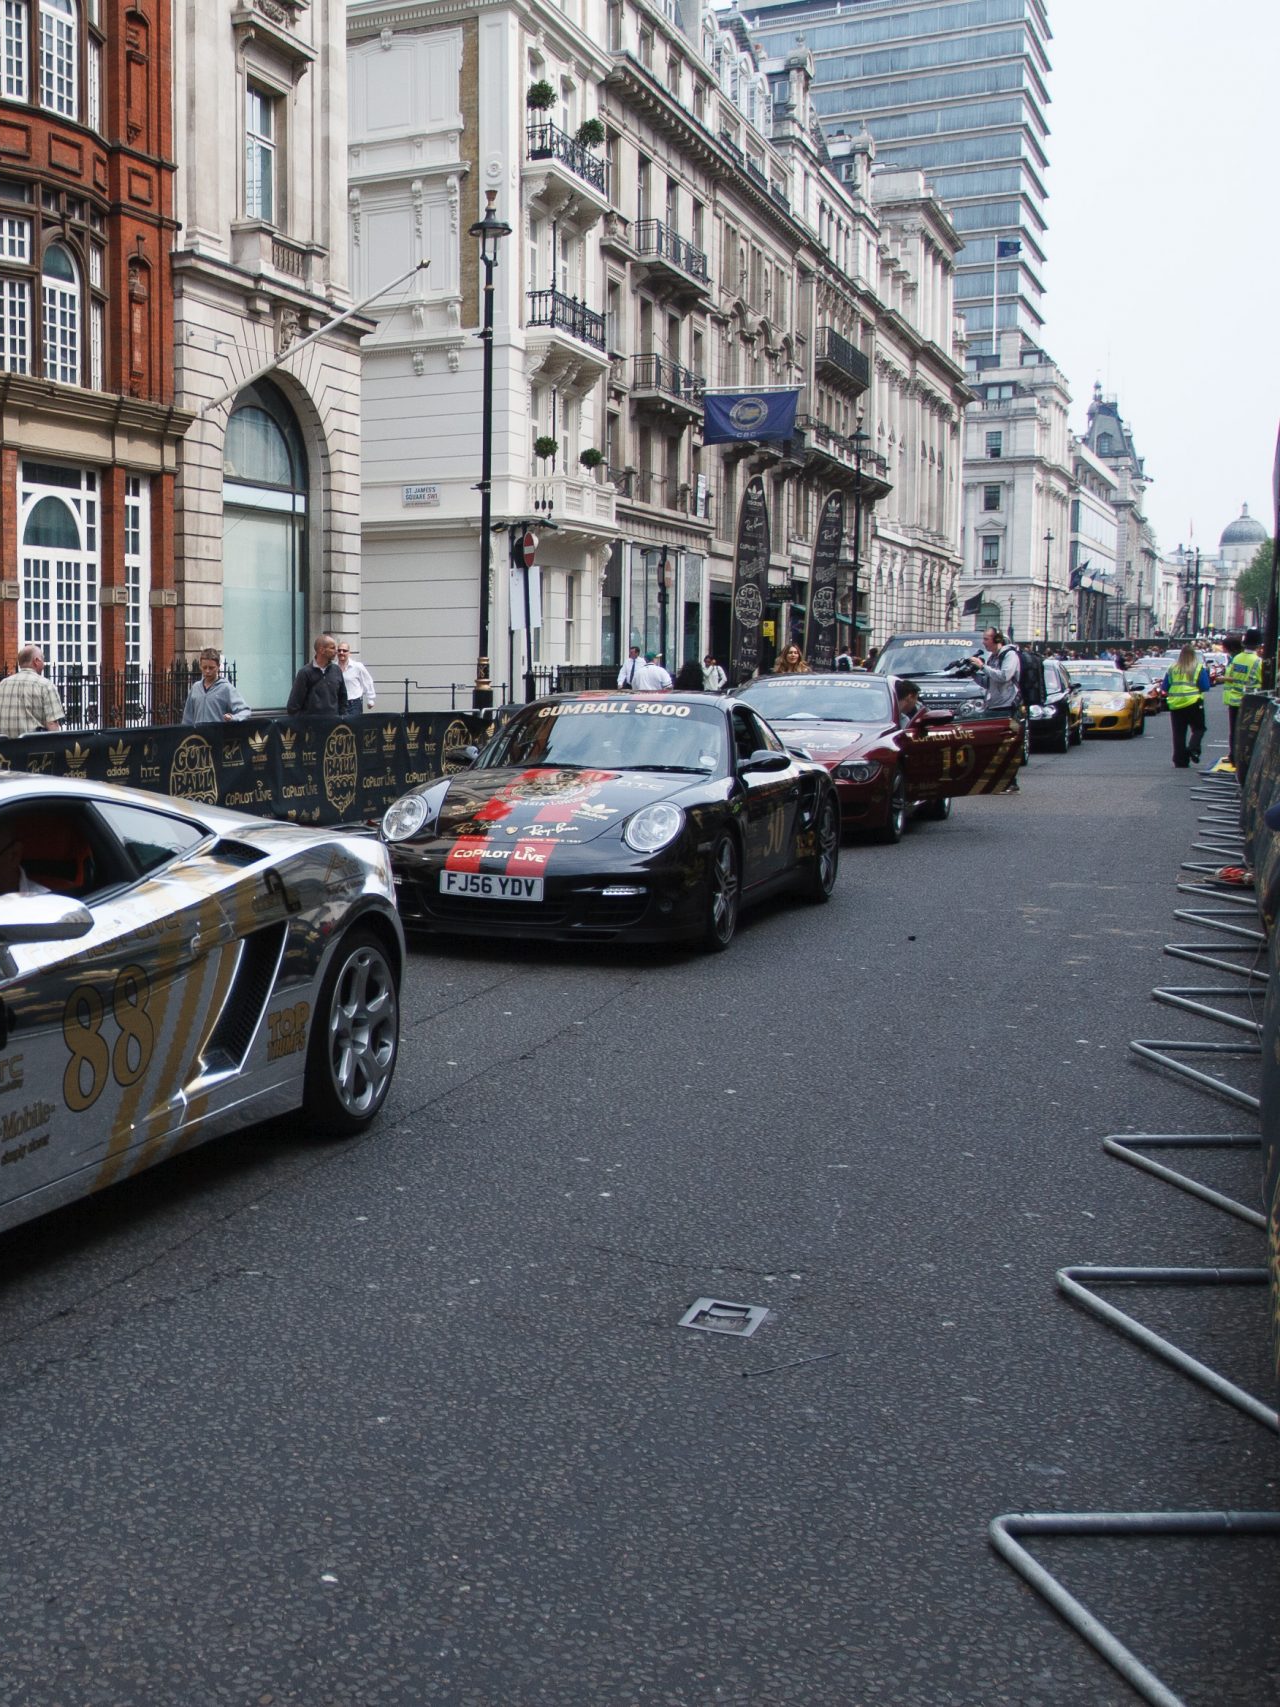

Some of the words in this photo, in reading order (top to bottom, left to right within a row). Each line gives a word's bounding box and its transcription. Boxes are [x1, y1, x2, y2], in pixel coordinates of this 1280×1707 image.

[904, 638, 947, 647] GUMBALL
[947, 638, 973, 647] 3000
[768, 679, 834, 688] GUMBALL
[835, 680, 870, 689] 3000
[538, 702, 631, 718] GUMBALL
[634, 702, 691, 717] 3000
[106, 766, 130, 777] adidas
[446, 873, 492, 893] FJ56
[496, 877, 535, 897] YDV
[267, 1001, 310, 1041] TOP
[62, 963, 155, 1112] 88
